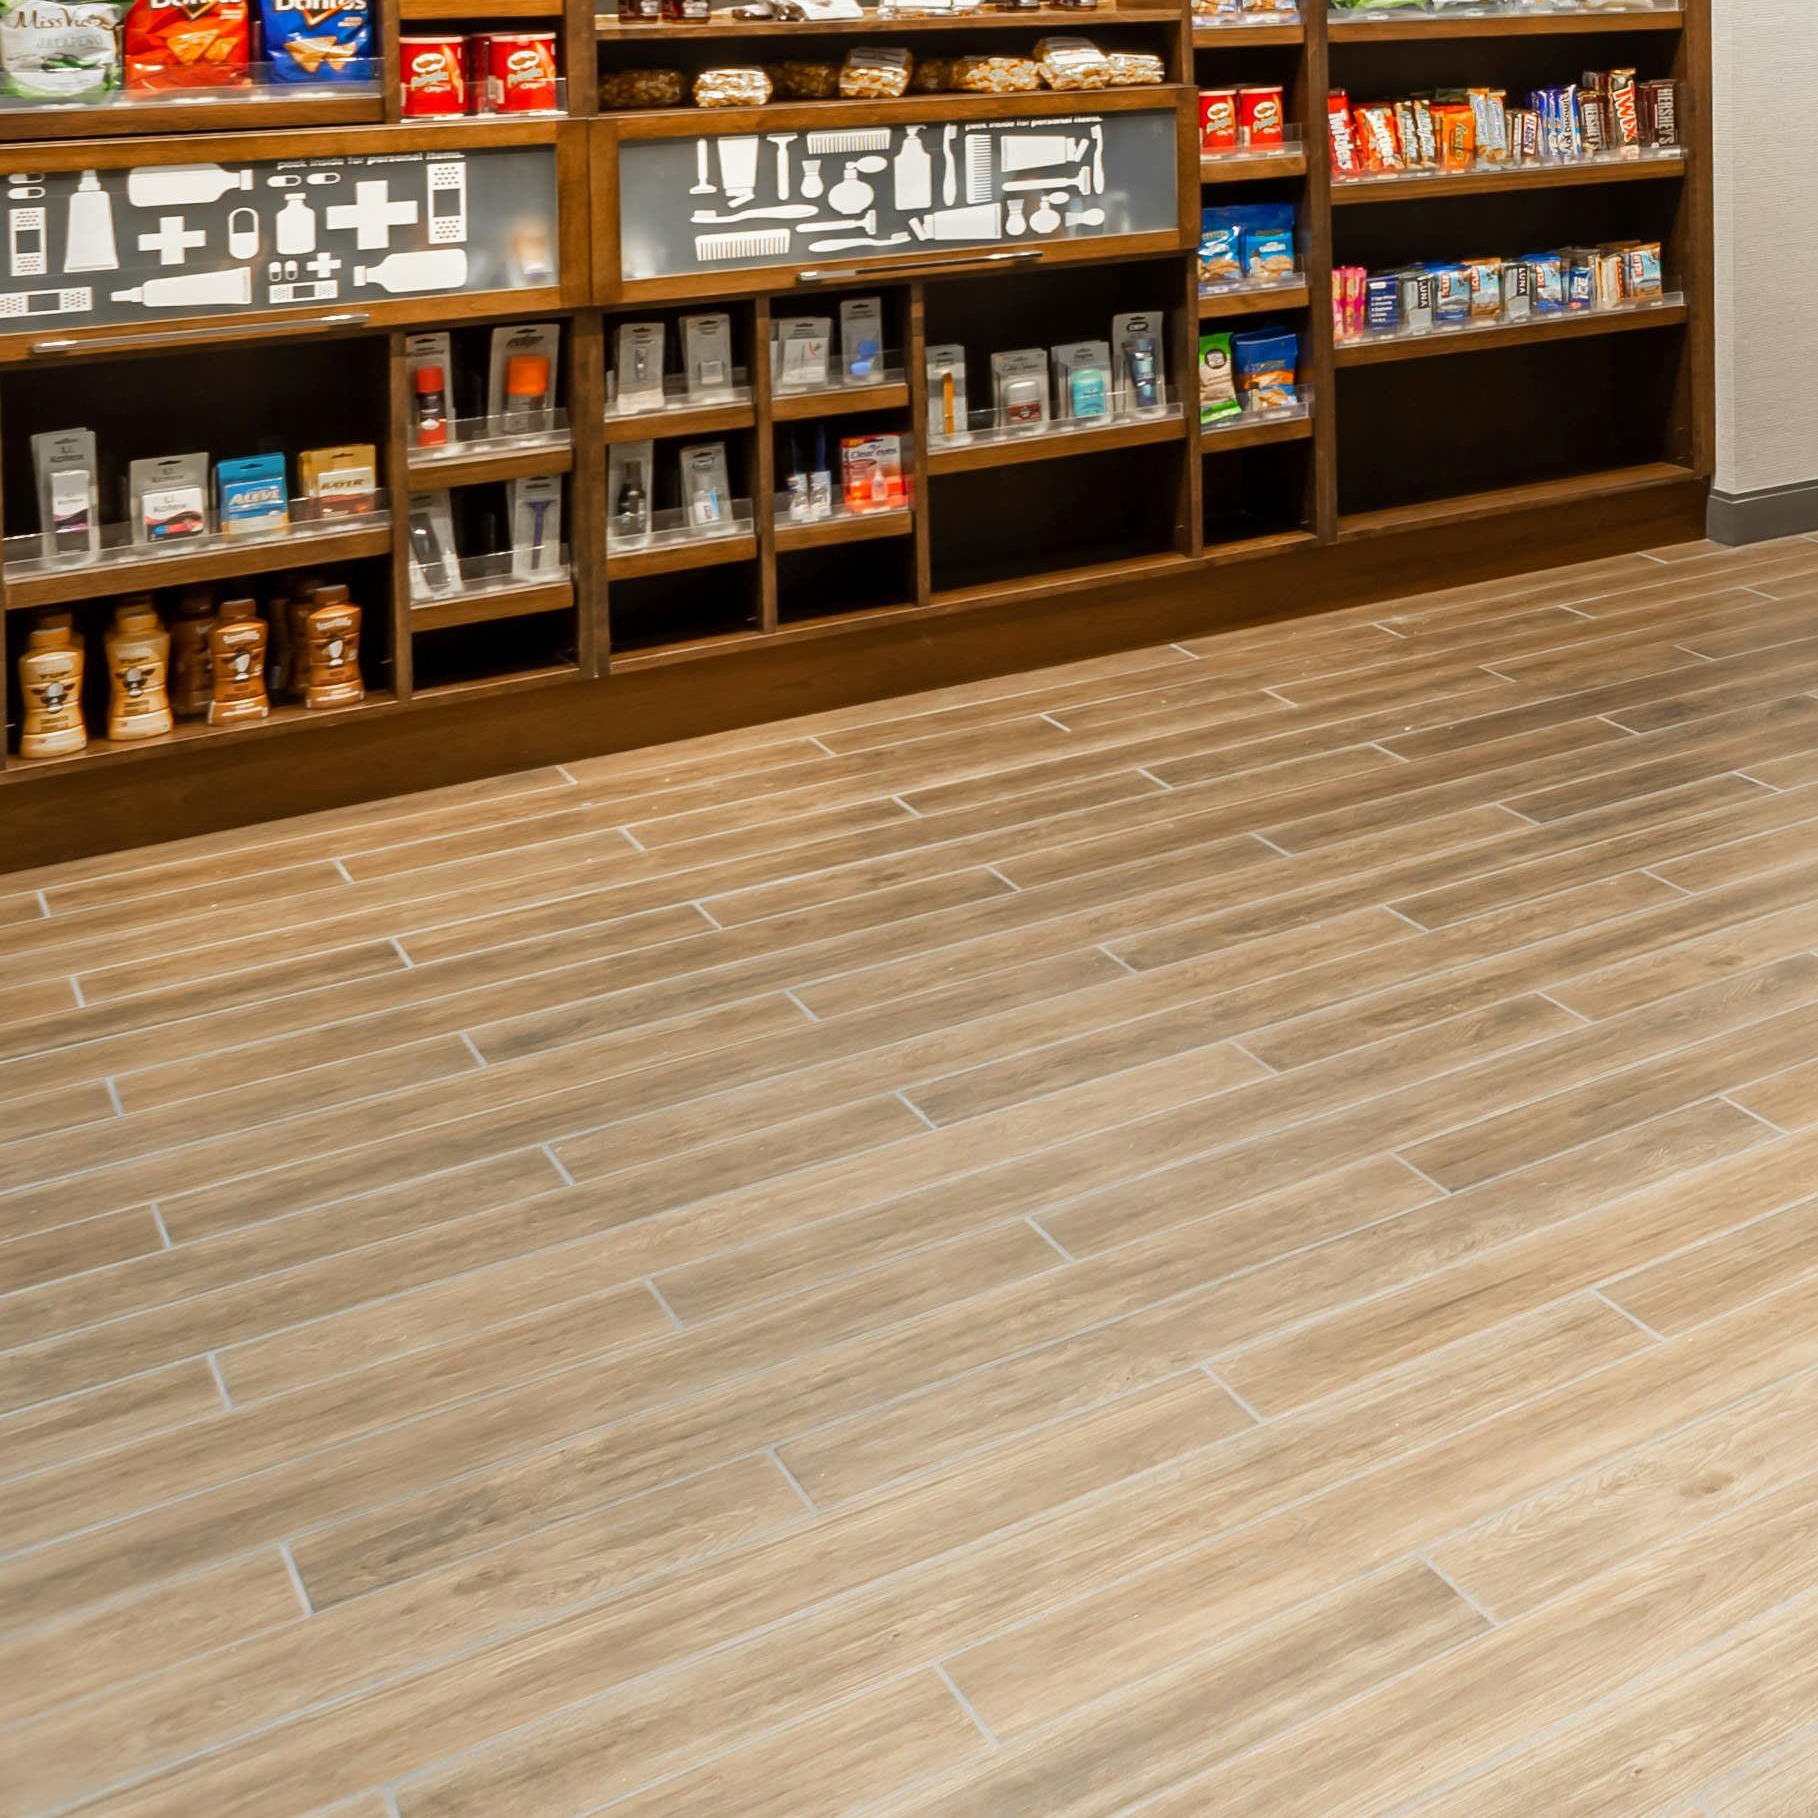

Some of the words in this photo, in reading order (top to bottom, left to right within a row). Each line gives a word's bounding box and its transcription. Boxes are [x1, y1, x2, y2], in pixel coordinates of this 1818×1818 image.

[1613, 79, 1639, 143] TWIX
[1657, 87, 1675, 145] HERSHEY'S
[1518, 267, 1527, 295] LUNA
